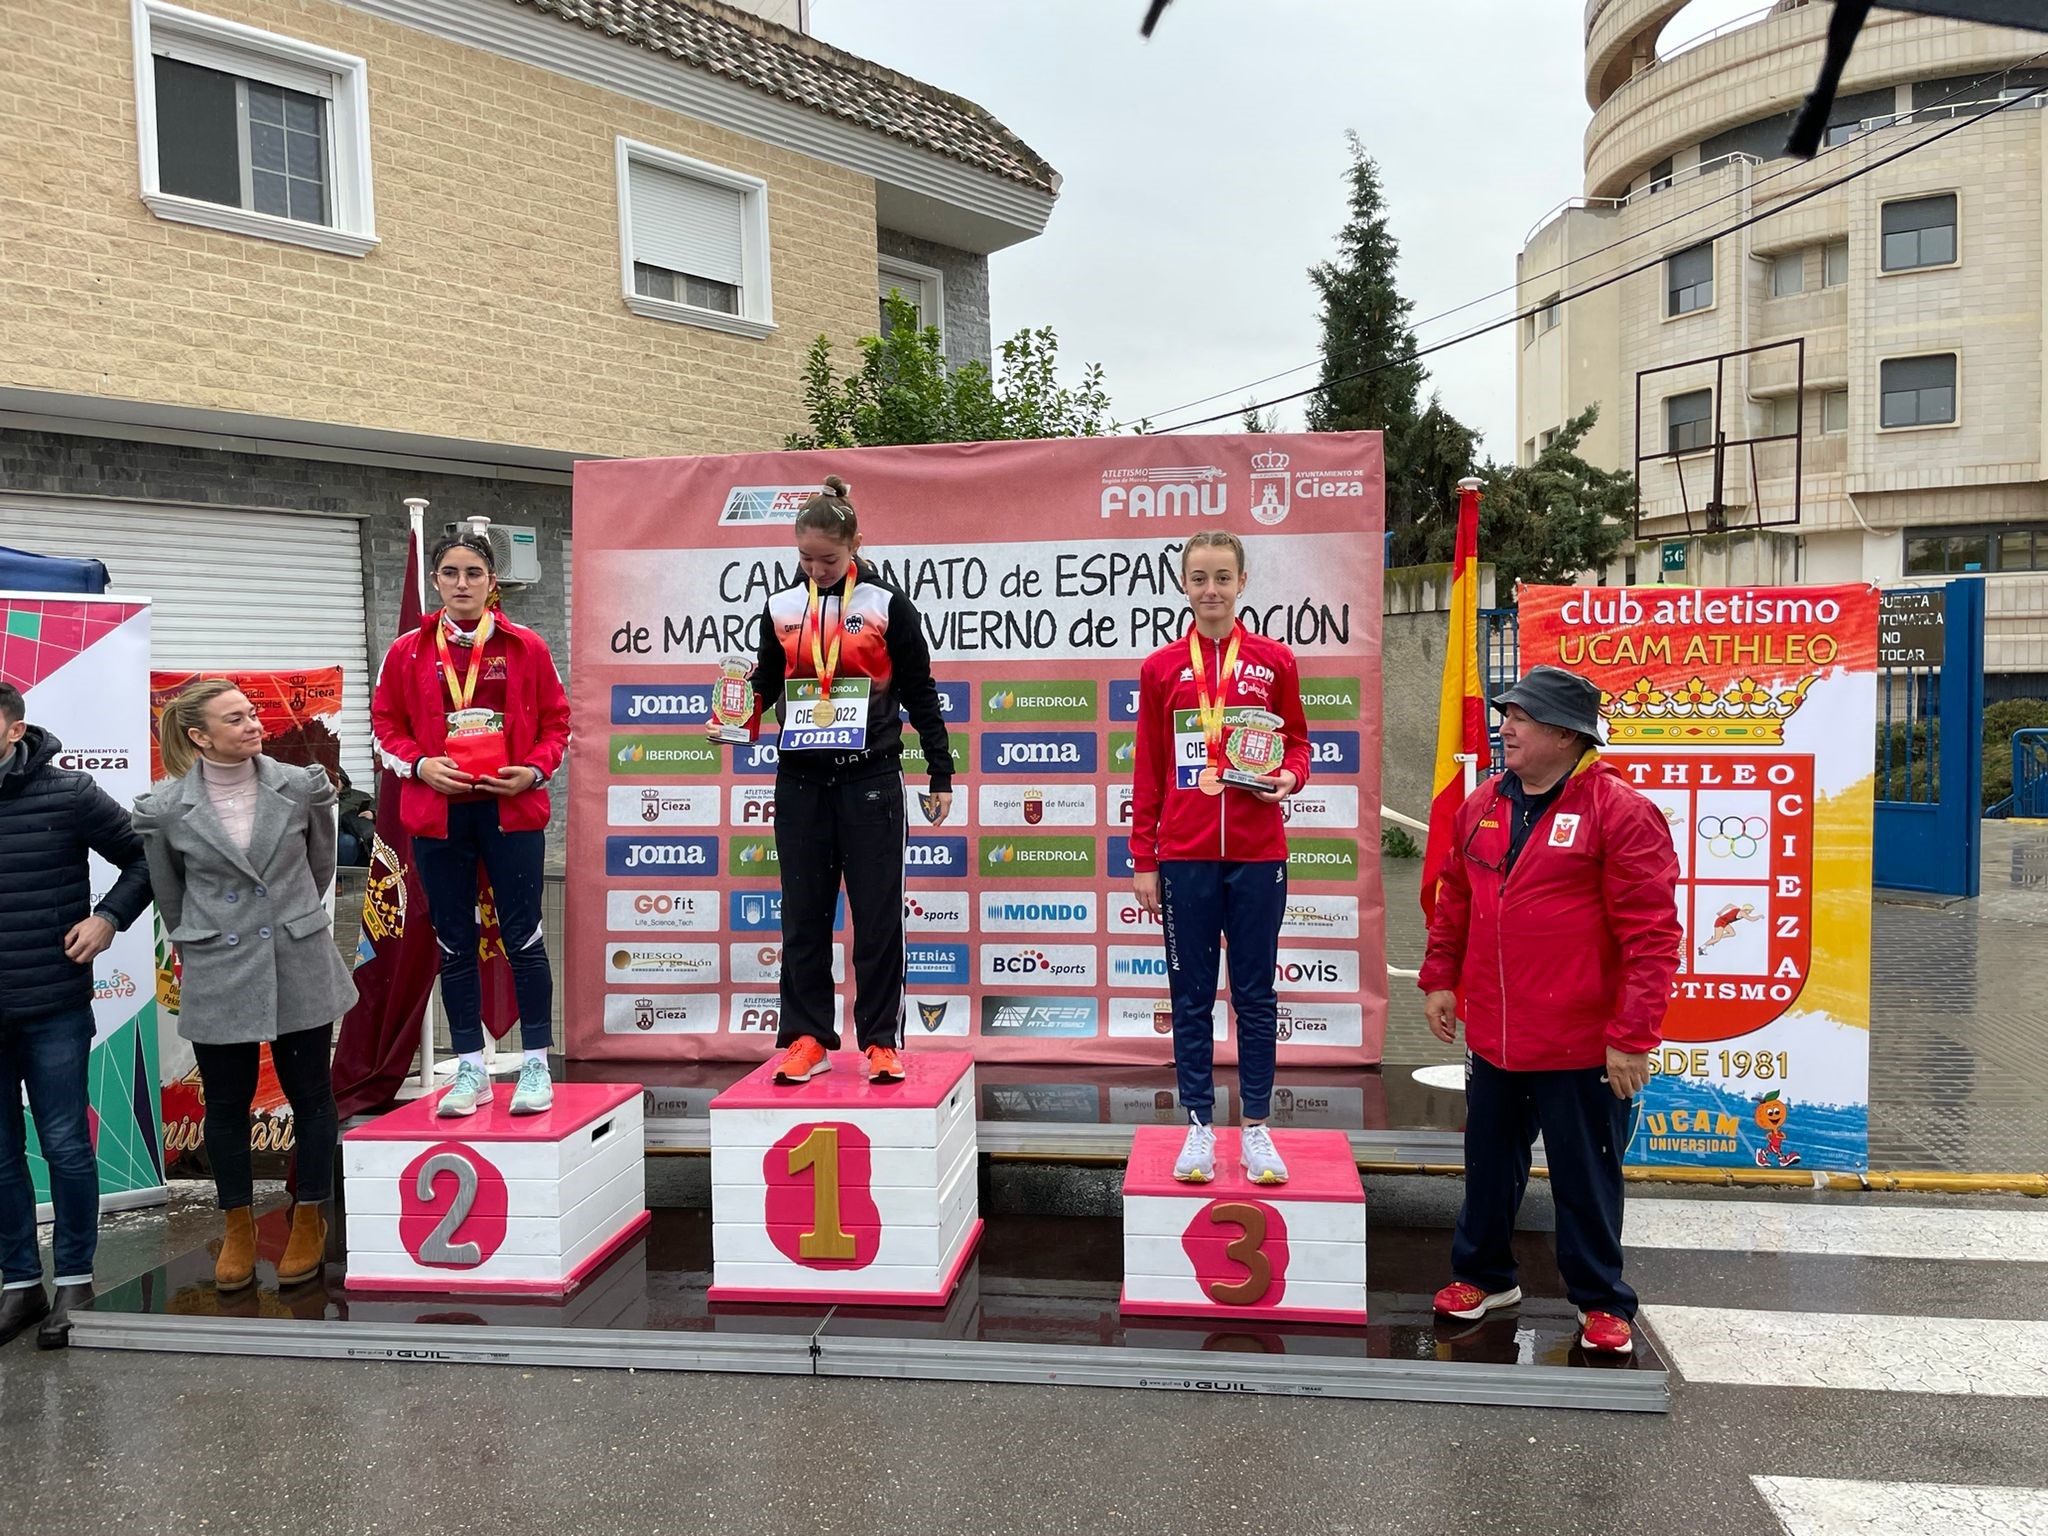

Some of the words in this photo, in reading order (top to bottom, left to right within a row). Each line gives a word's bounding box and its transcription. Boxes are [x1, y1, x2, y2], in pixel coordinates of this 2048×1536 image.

[1102, 468, 1149, 478] ATLETISMO
[1295, 478, 1363, 498] Cieza
[1101, 483, 1227, 518] FAMU
[1664, 550, 1684, 562] 56
[1000, 563, 1042, 598] de
[1055, 543, 1186, 598] ESPAÑ
[1560, 589, 1643, 625] club
[1653, 591, 1841, 624] atletismo
[610, 621, 652, 653] de
[663, 613, 764, 654] MARC
[917, 609, 1058, 651] VIERNO
[1068, 608, 1118, 648] de
[1131, 597, 1349, 647] PROOCIÓN
[1882, 631, 1901, 644] NO
[1558, 635, 1672, 666] UCAM
[1683, 632, 1838, 665] ATHLEO
[1880, 649, 1925, 661] TOCAR
[1244, 664, 1275, 682] ADM
[307, 687, 335, 698] Cieza
[1300, 694, 1352, 705] RDROLA
[254, 700, 282, 712] eportes
[628, 694, 708, 717] Joma
[1016, 696, 1088, 708] IBERDROLA
[834, 707, 857, 722] 022
[790, 730, 852, 748] Joma
[645, 750, 714, 761] IBERDROLA
[748, 745, 778, 766] Jo
[997, 742, 1080, 766] Joma
[1186, 742, 1207, 759] CIE
[59, 754, 129, 770] Cieza
[1628, 762, 1795, 784] THLEO
[661, 802, 691, 811] Cieza
[743, 801, 777, 823] FA
[993, 799, 1021, 809] Región
[1045, 800, 1055, 808] de
[1057, 800, 1085, 808] Murcia
[1293, 803, 1326, 813] Cieza
[625, 844, 706, 867] Joma
[905, 845, 952, 865] ma
[1016, 850, 1089, 862] IBERDROLA
[1288, 853, 1352, 864] ERDROLA
[924, 911, 959, 922] sports
[1004, 904, 1088, 921] MONDO
[1302, 912, 1349, 922] gestión
[1166, 903, 1181, 971] MARATHON
[632, 952, 683, 960] RIESGO
[669, 959, 712, 968] gestión
[907, 949, 956, 962] TERÍAS
[993, 957, 1037, 973] BCD
[1050, 964, 1086, 975] sports
[1276, 959, 1340, 982] novis
[93, 985, 135, 999] ueve
[1671, 982, 1793, 1001] TISMO
[656, 1010, 687, 1020] Cieza
[741, 1009, 778, 1031] FA
[1031, 1006, 1091, 1020] RFEA
[1122, 1011, 1151, 1021] Región
[1295, 1021, 1327, 1031] Cieza
[1719, 1050, 1789, 1080] 1981
[1646, 1109, 1740, 1138] UCAM
[1649, 1137, 1737, 1153] UNIVERSIDAD
[789, 1128, 857, 1260] 1
[416, 1154, 482, 1265] 2
[1210, 1202, 1272, 1304] 3
[397, 1350, 450, 1359] GUIL
[1196, 1381, 1256, 1392] GUIL
